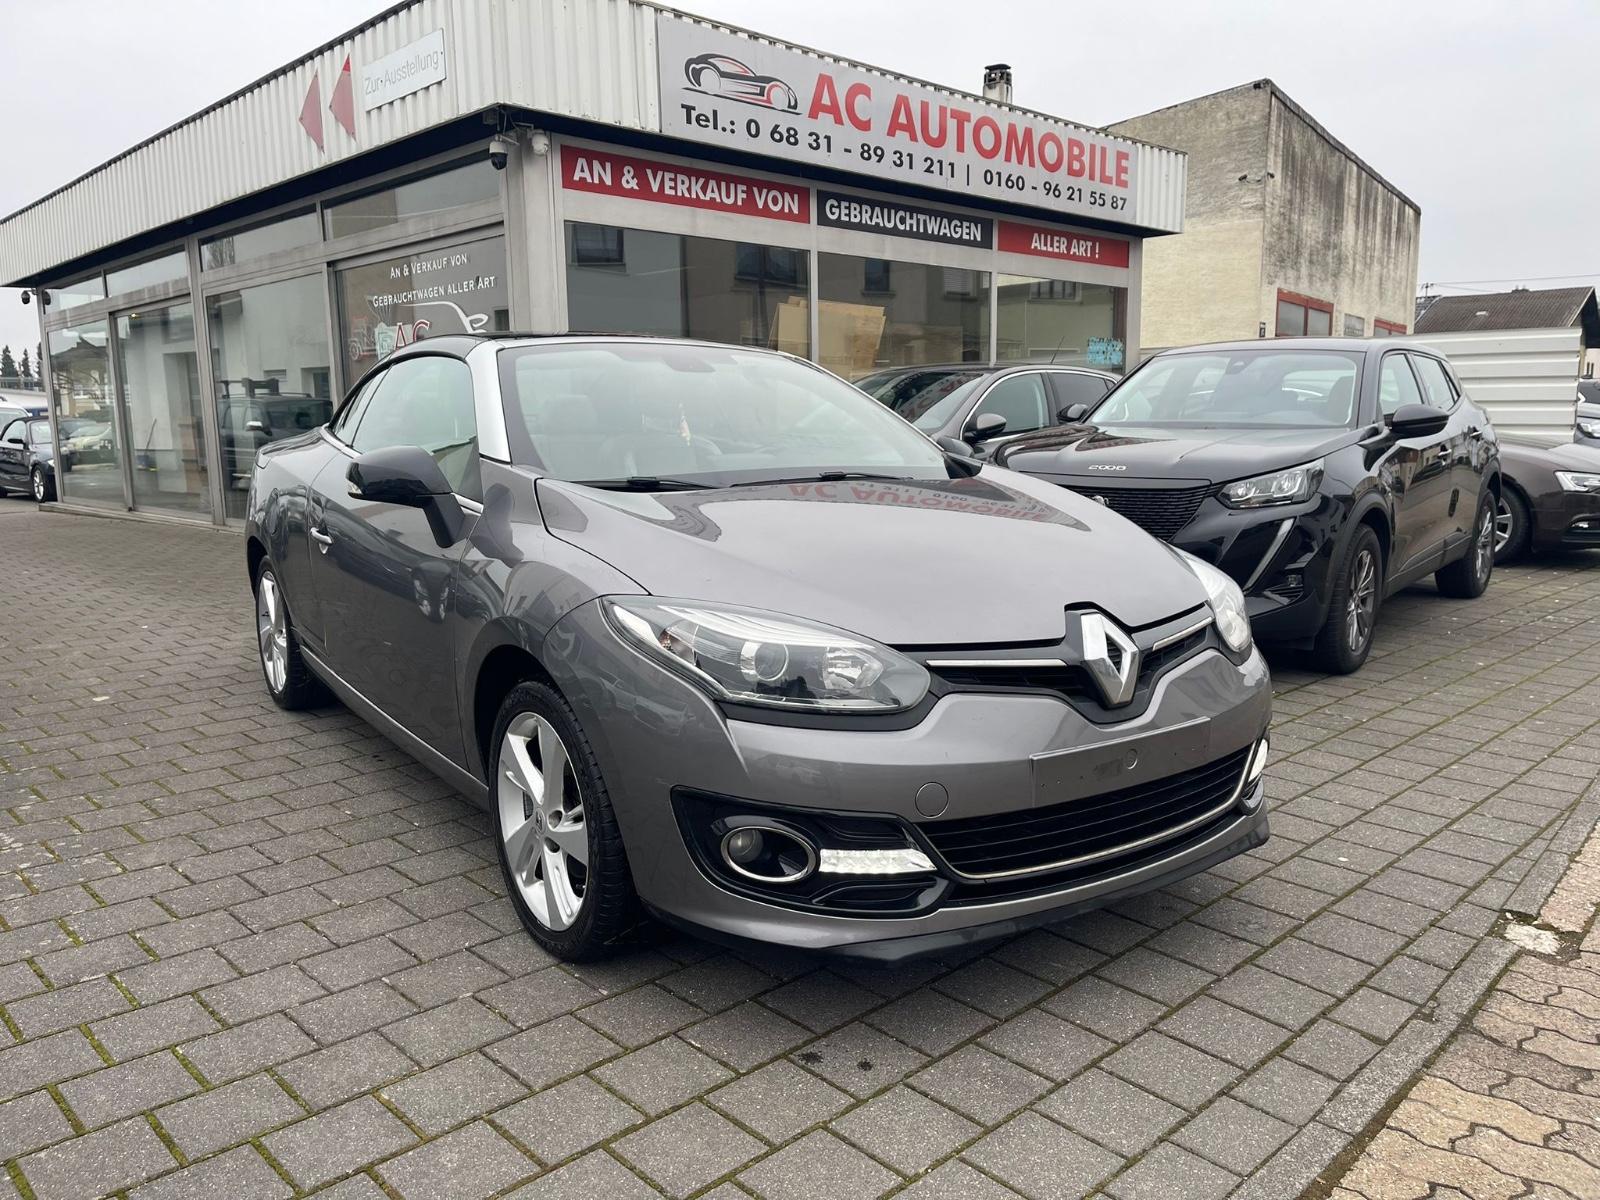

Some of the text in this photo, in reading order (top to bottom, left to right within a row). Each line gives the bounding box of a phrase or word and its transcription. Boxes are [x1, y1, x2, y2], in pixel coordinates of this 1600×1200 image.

[364, 51, 439, 96] Zur Ausstellung
[807, 72, 1129, 188] AC AUTOMOBILE
[681, 103, 736, 134] Tel.:
[746, 118, 761, 138] 0
[769, 124, 799, 146] 68
[807, 131, 832, 153] 31
[859, 143, 885, 163] 89
[892, 150, 913, 170] 31
[923, 156, 955, 178] 211
[983, 169, 1025, 191] 0160
[1043, 181, 1061, 198] 96
[1066, 187, 1082, 202] 21
[1089, 191, 1106, 207] 55
[1111, 194, 1127, 211] 87
[573, 157, 799, 214] AN & VERKAUF VON
[825, 198, 981, 242] GEBRAUCHTWAGEN
[1031, 233, 1100, 258] ALLER ART !
[403, 264, 410, 276] &
